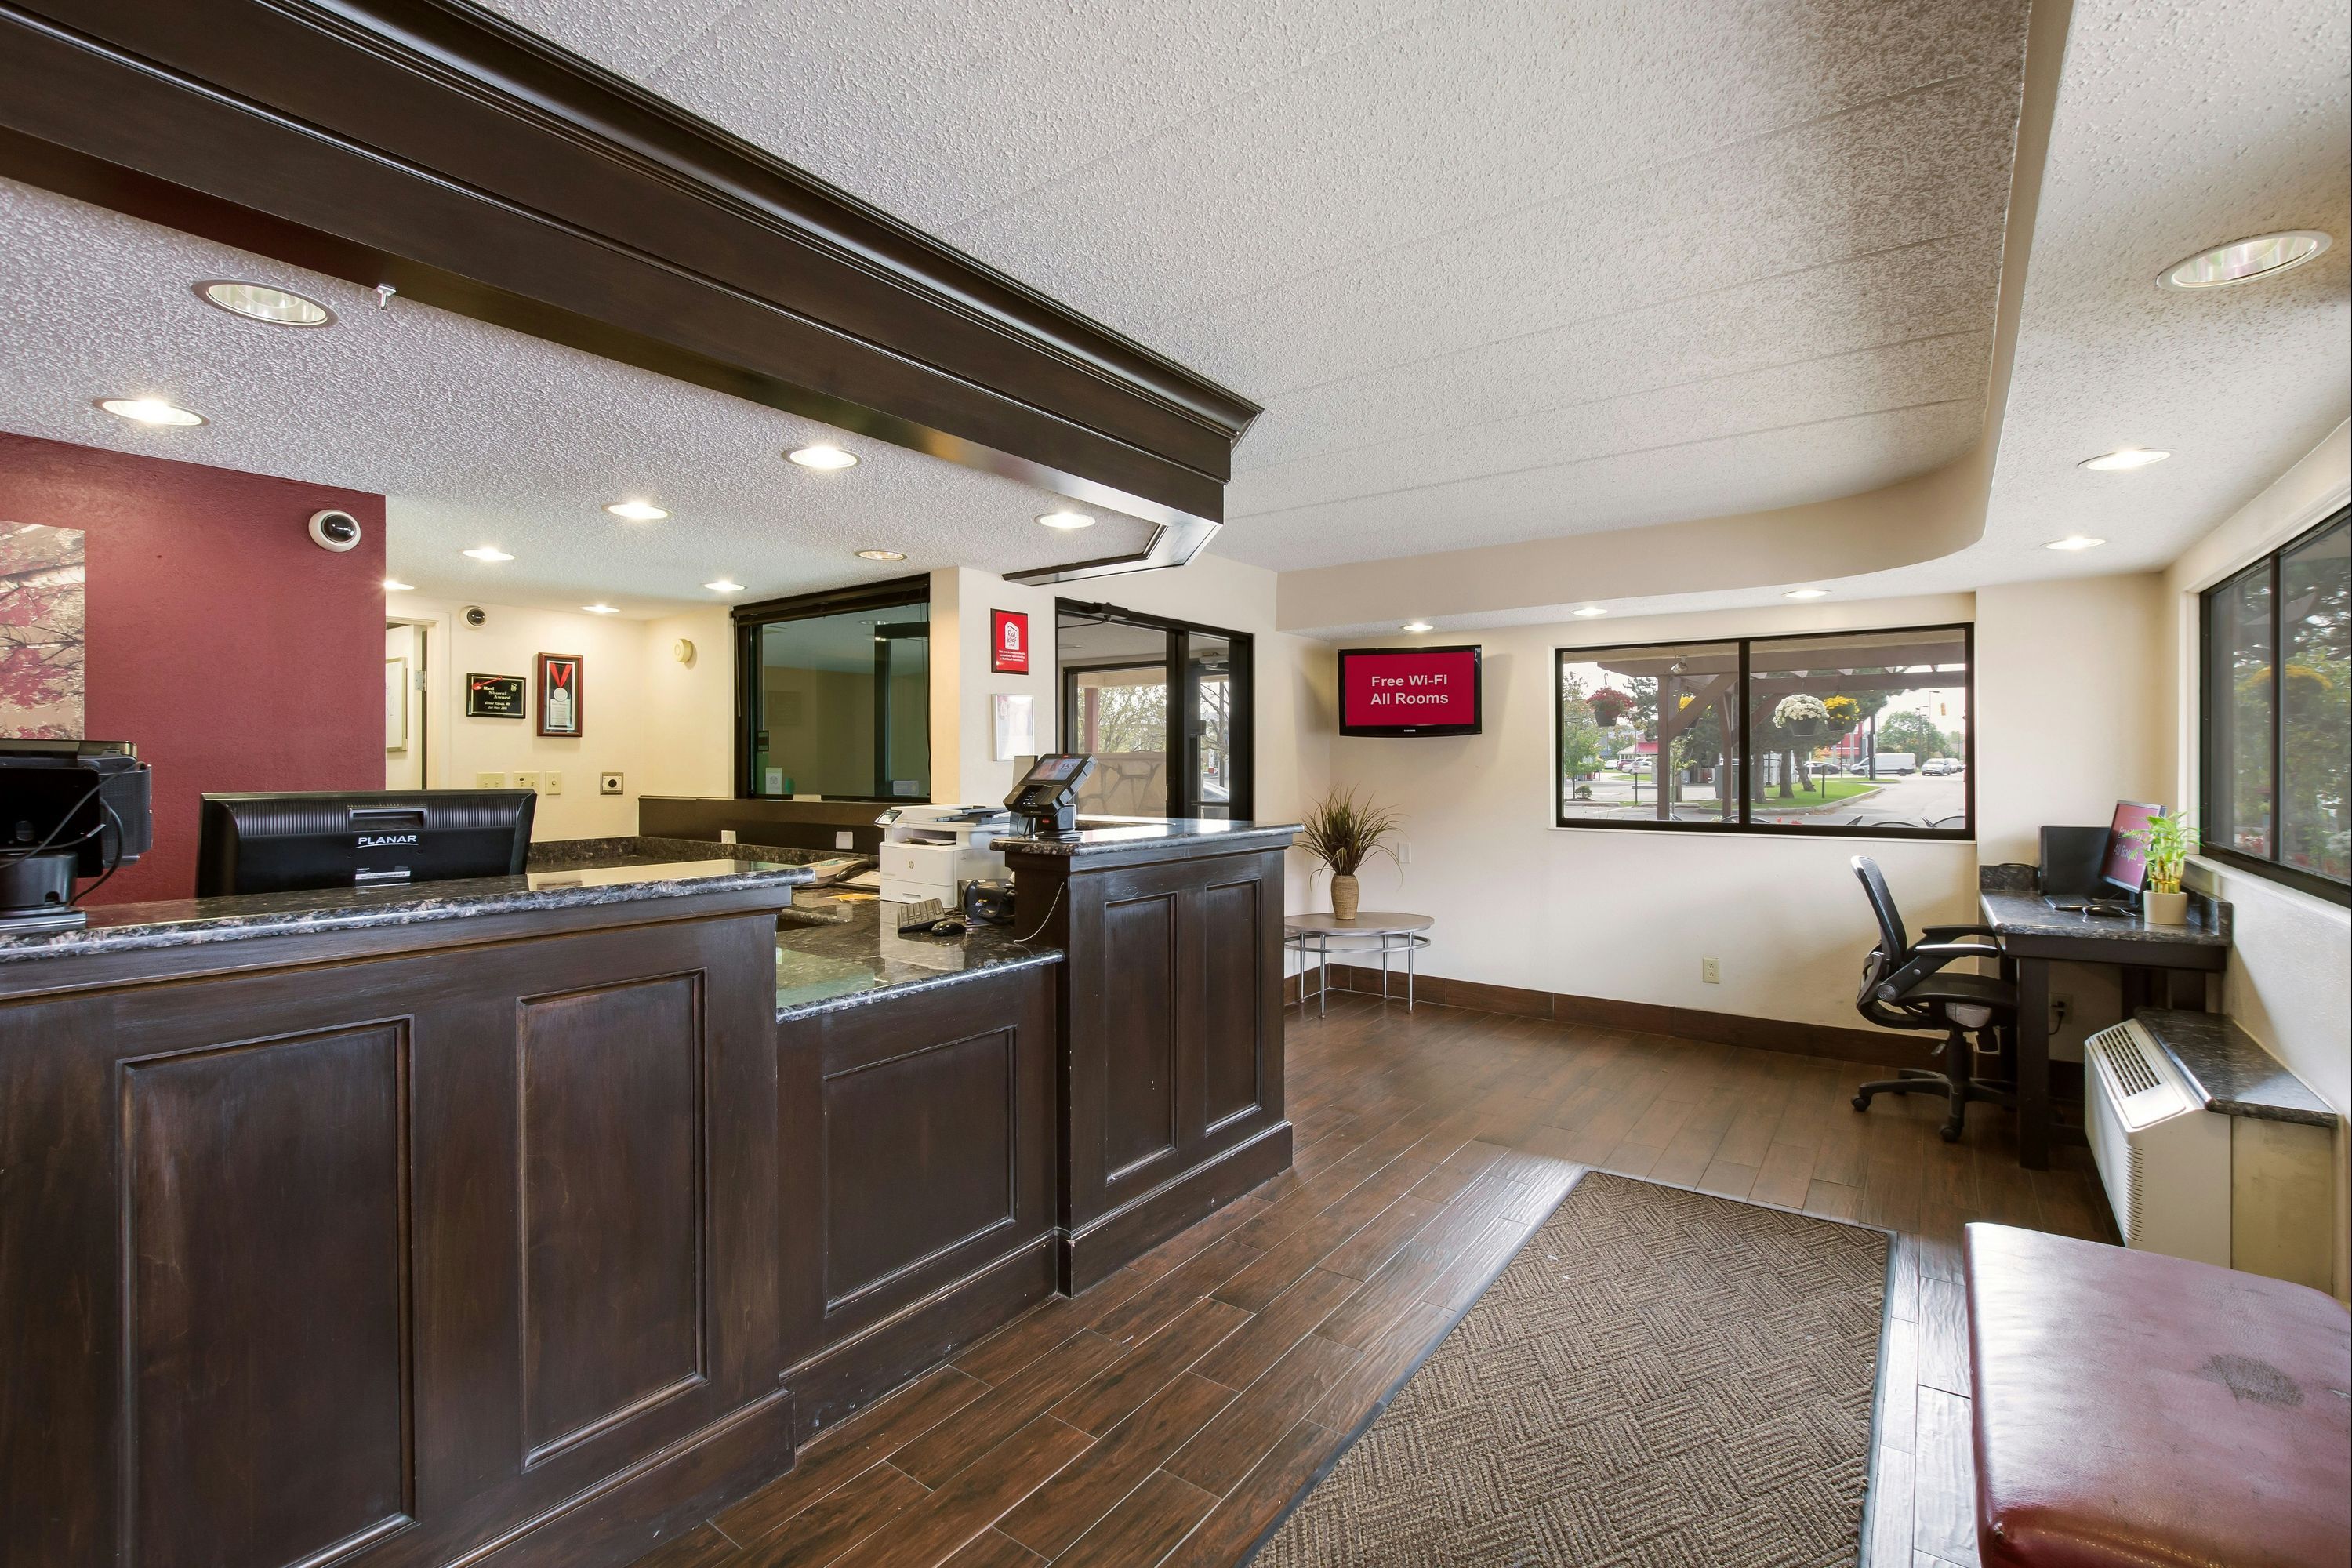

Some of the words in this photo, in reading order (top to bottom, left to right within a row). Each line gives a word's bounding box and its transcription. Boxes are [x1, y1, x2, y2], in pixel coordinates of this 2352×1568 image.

[1007, 636, 1018, 644] Roof
[1371, 676, 1404, 687] Free
[1408, 674, 1447, 686] Wi-Fi
[1370, 692, 1390, 705] All
[1396, 692, 1449, 705] Rooms
[358, 835, 417, 844] PLANAR
